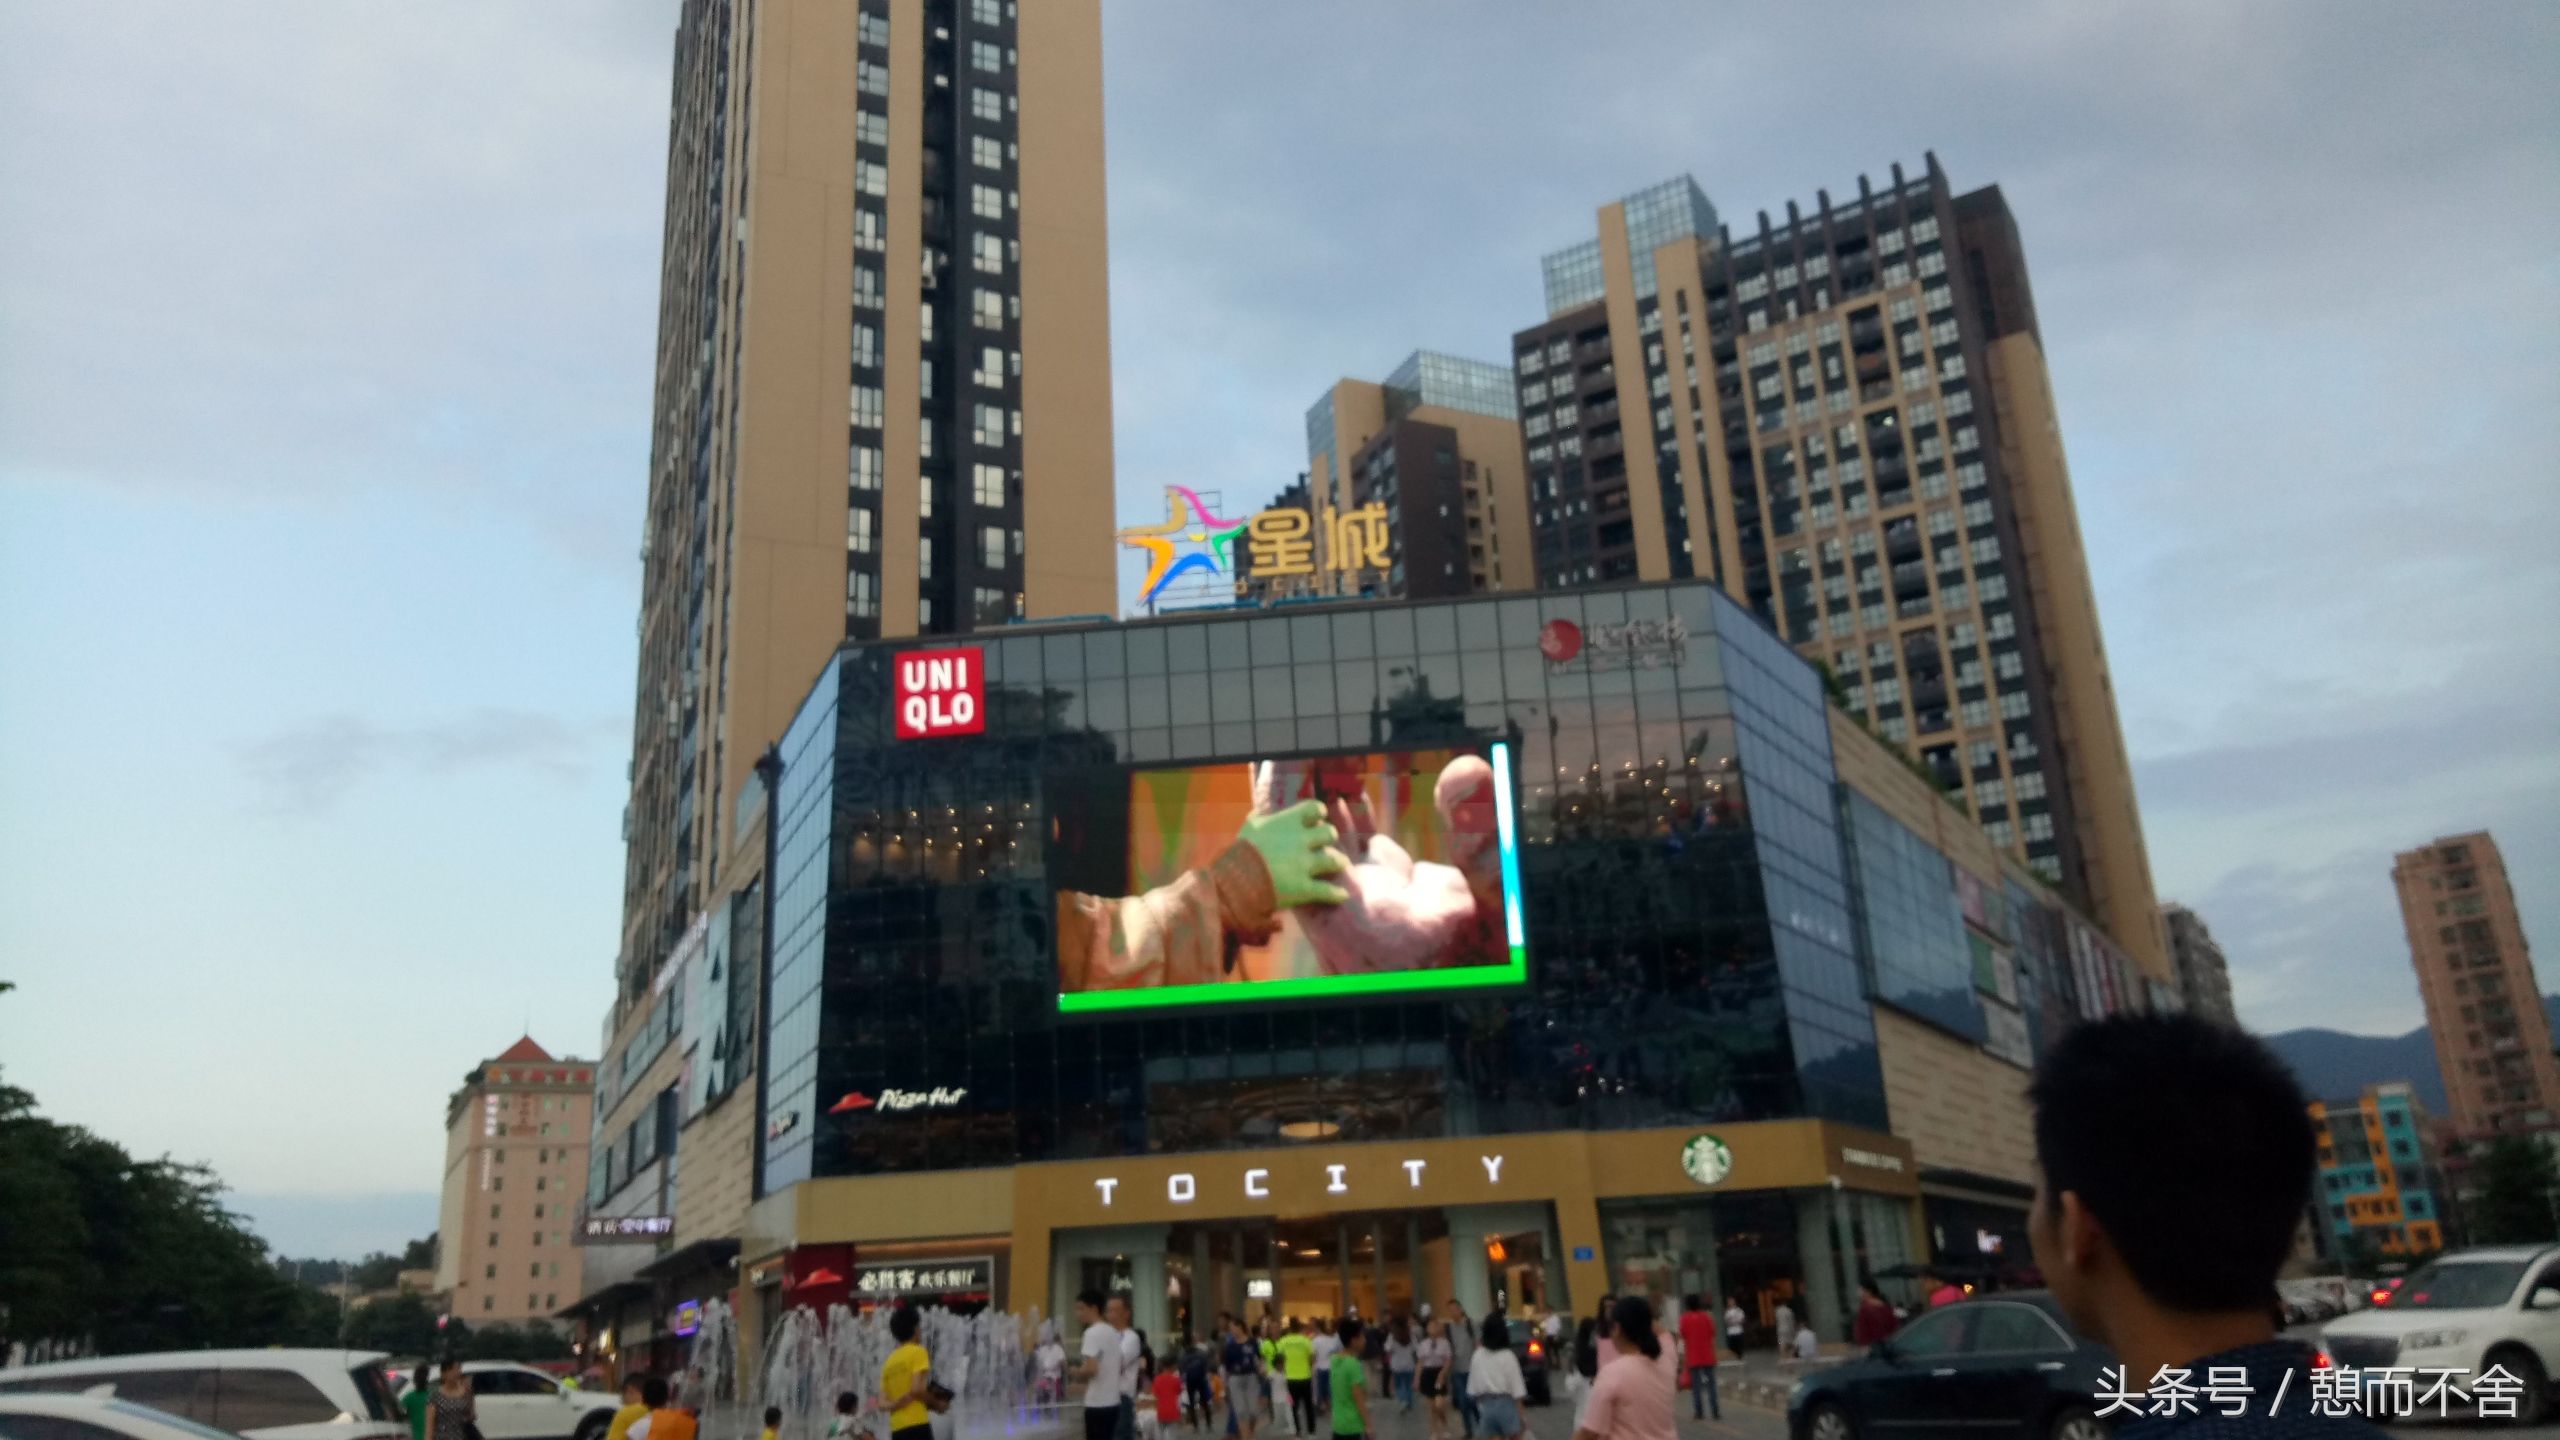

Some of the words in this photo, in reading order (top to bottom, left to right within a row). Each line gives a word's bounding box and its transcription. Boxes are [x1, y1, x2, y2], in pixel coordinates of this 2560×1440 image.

[1248, 502, 1392, 576] 星城
[904, 656, 967, 693] UNI
[904, 691, 974, 733] QLO
[875, 1088, 927, 1112] Pizza
[928, 1086, 967, 1107] Hut
